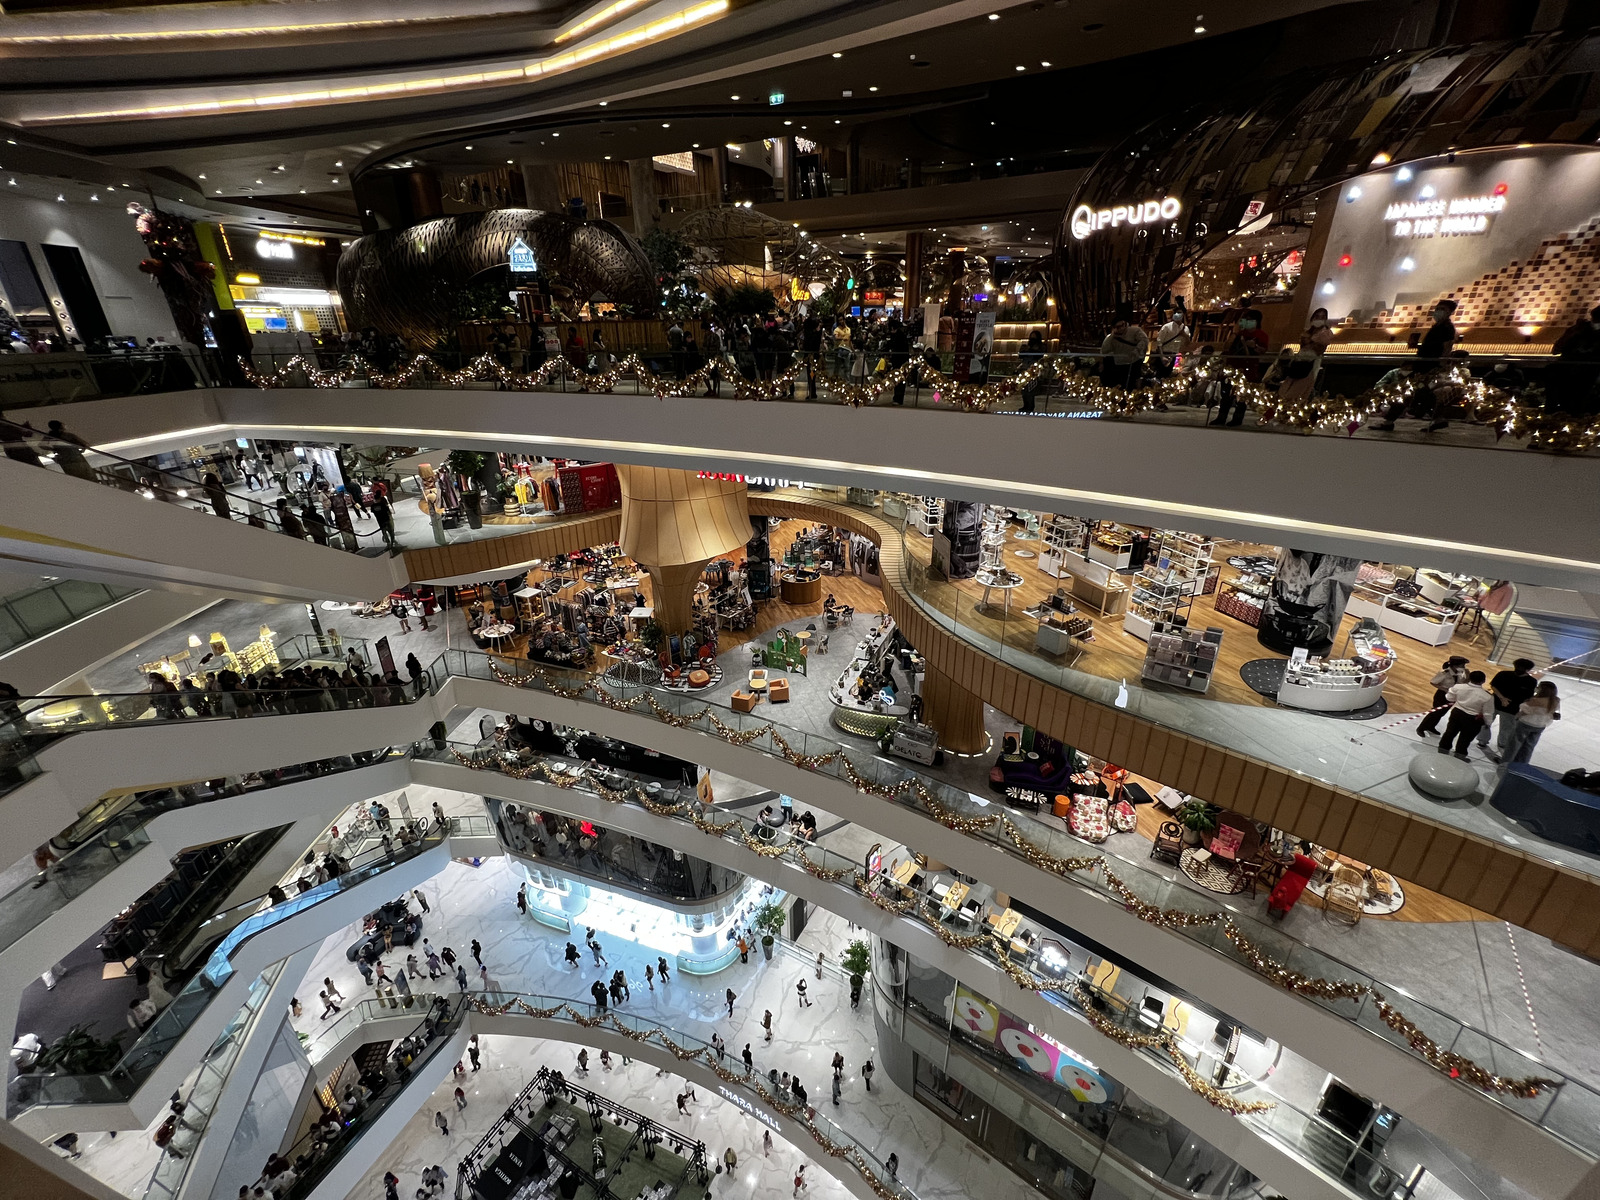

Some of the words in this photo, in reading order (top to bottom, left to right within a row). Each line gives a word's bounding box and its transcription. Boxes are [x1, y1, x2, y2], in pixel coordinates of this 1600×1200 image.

[1384, 200, 1446, 220] JAPANESE
[1394, 220, 1412, 235] TO
[1414, 218, 1438, 234] THE
[1440, 215, 1488, 232] WORLD
[719, 1086, 753, 1112] THARA
[755, 1108, 781, 1132] HALL
